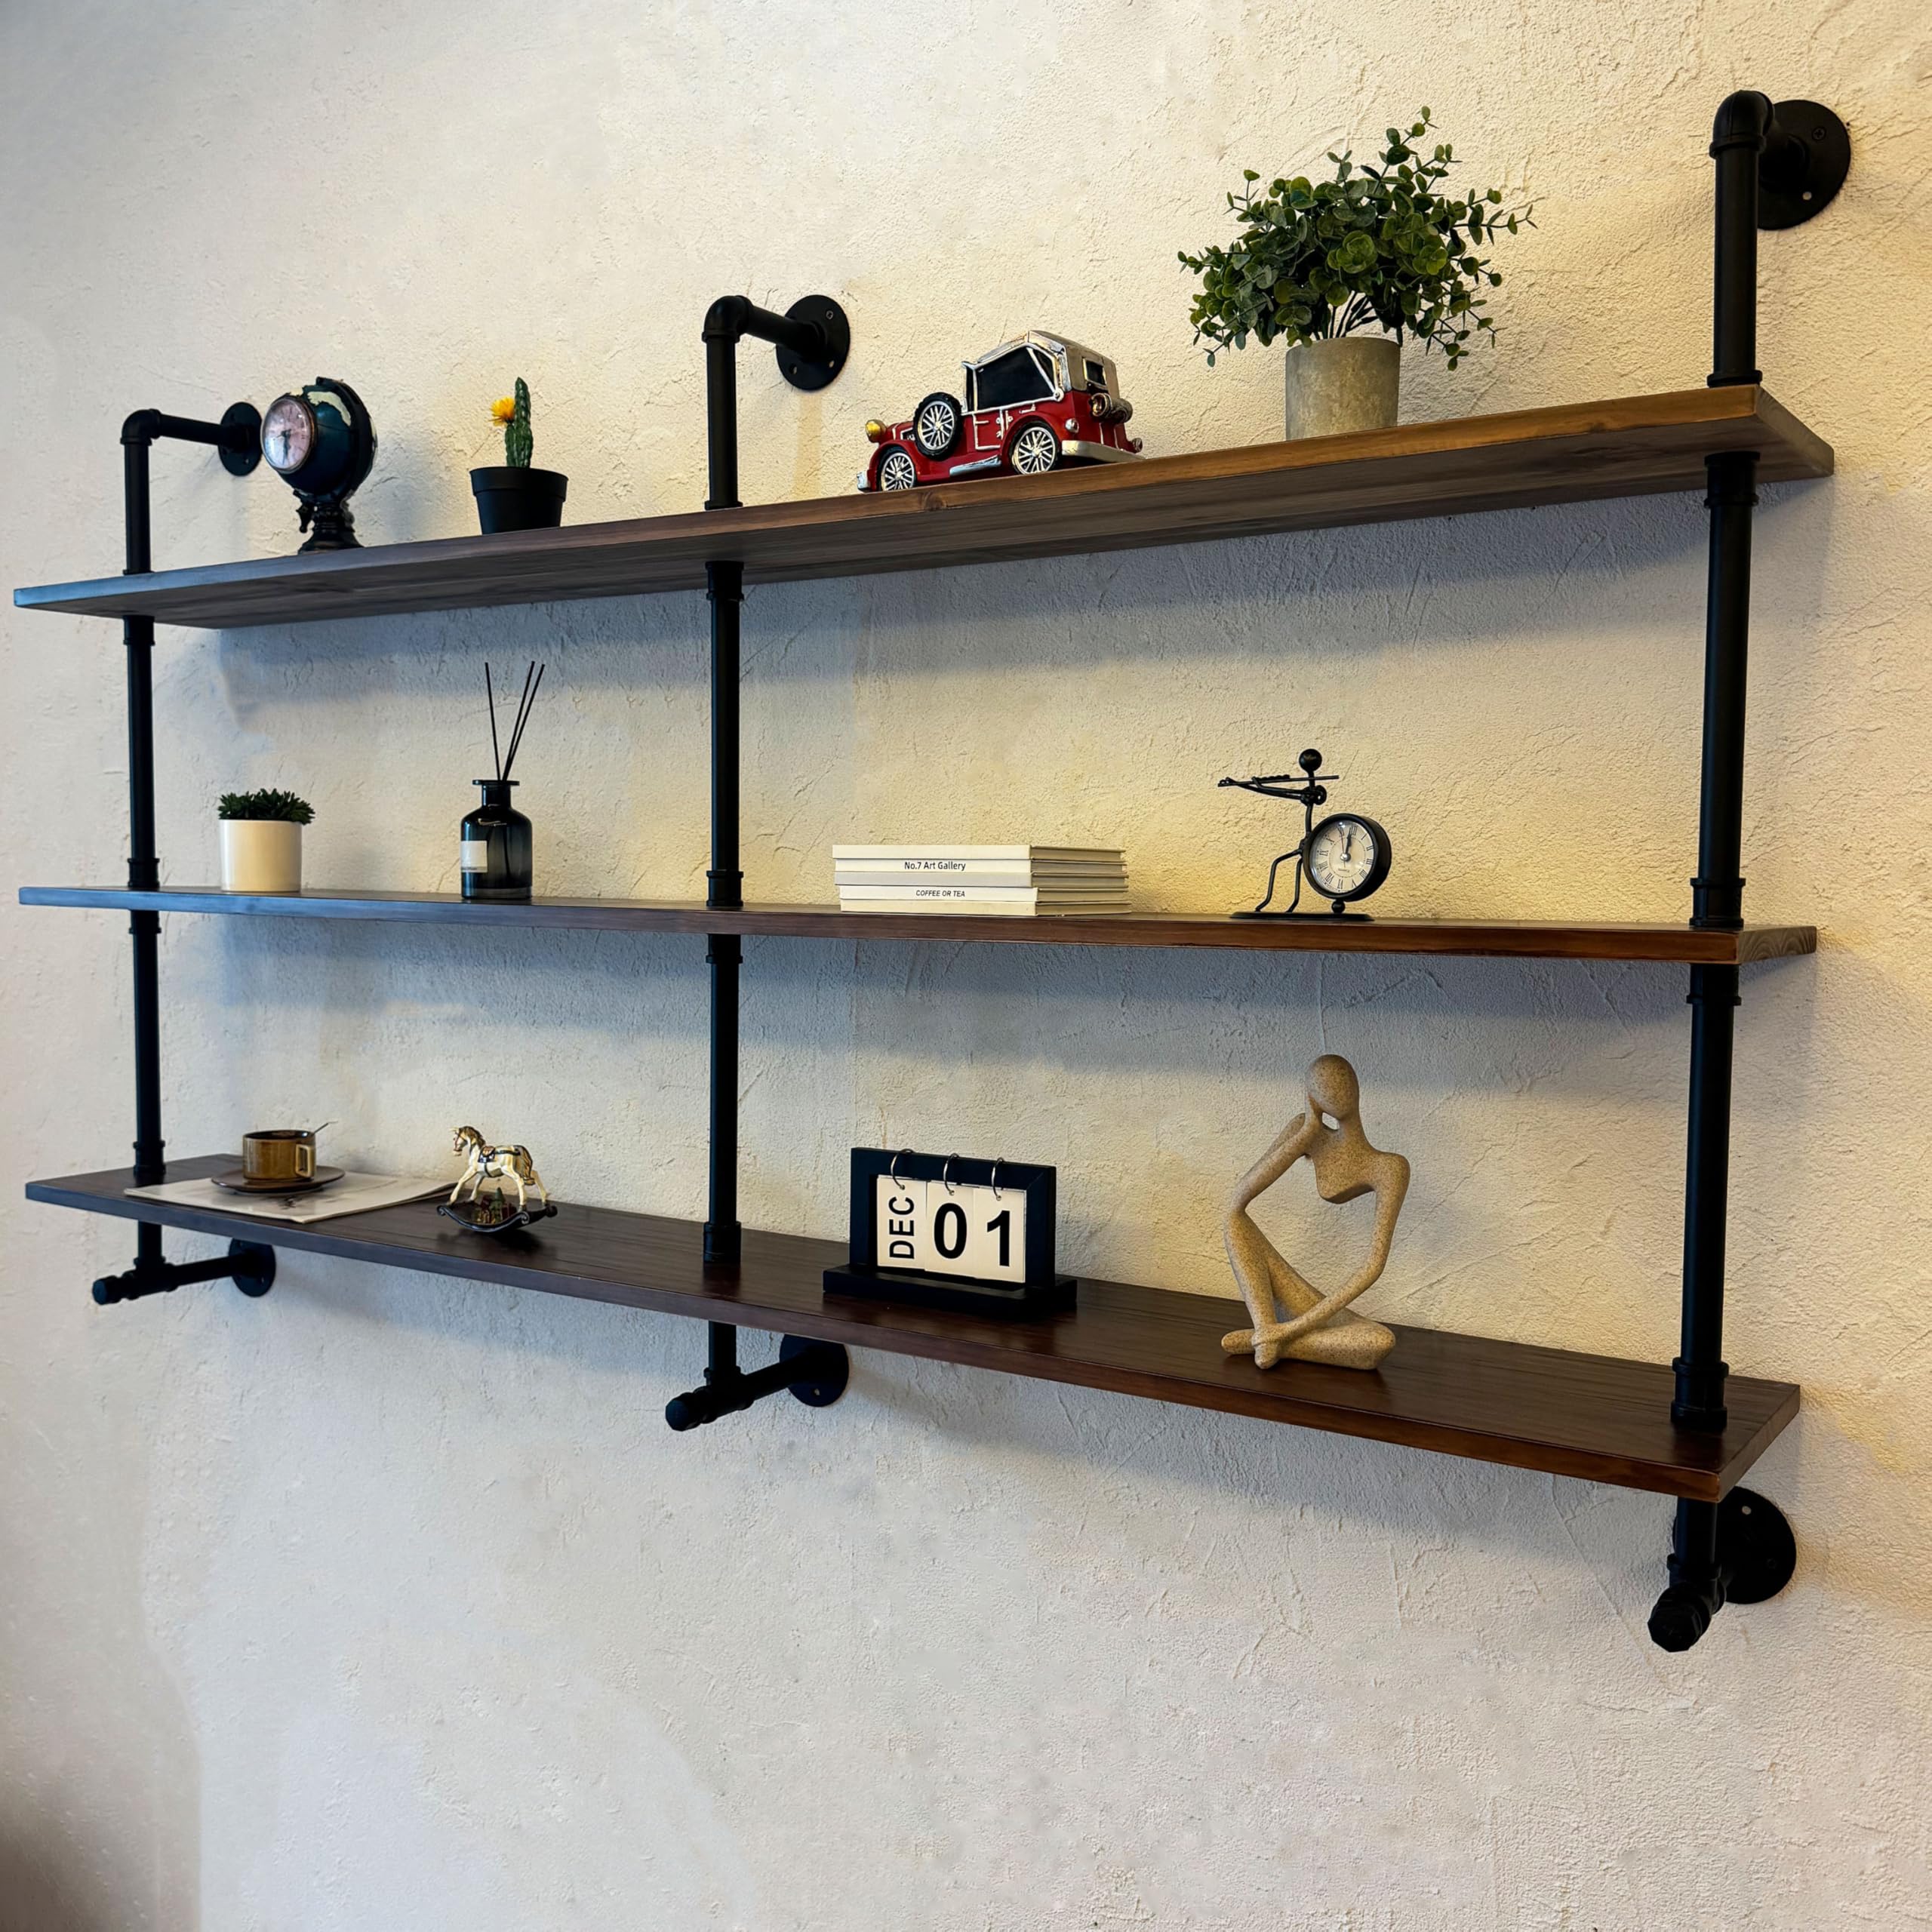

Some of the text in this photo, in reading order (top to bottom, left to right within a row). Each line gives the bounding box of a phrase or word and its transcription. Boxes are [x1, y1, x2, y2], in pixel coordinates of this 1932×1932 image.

[904, 861, 966, 871] No.7 Art Gallery
[888, 1196, 915, 1260] DEC
